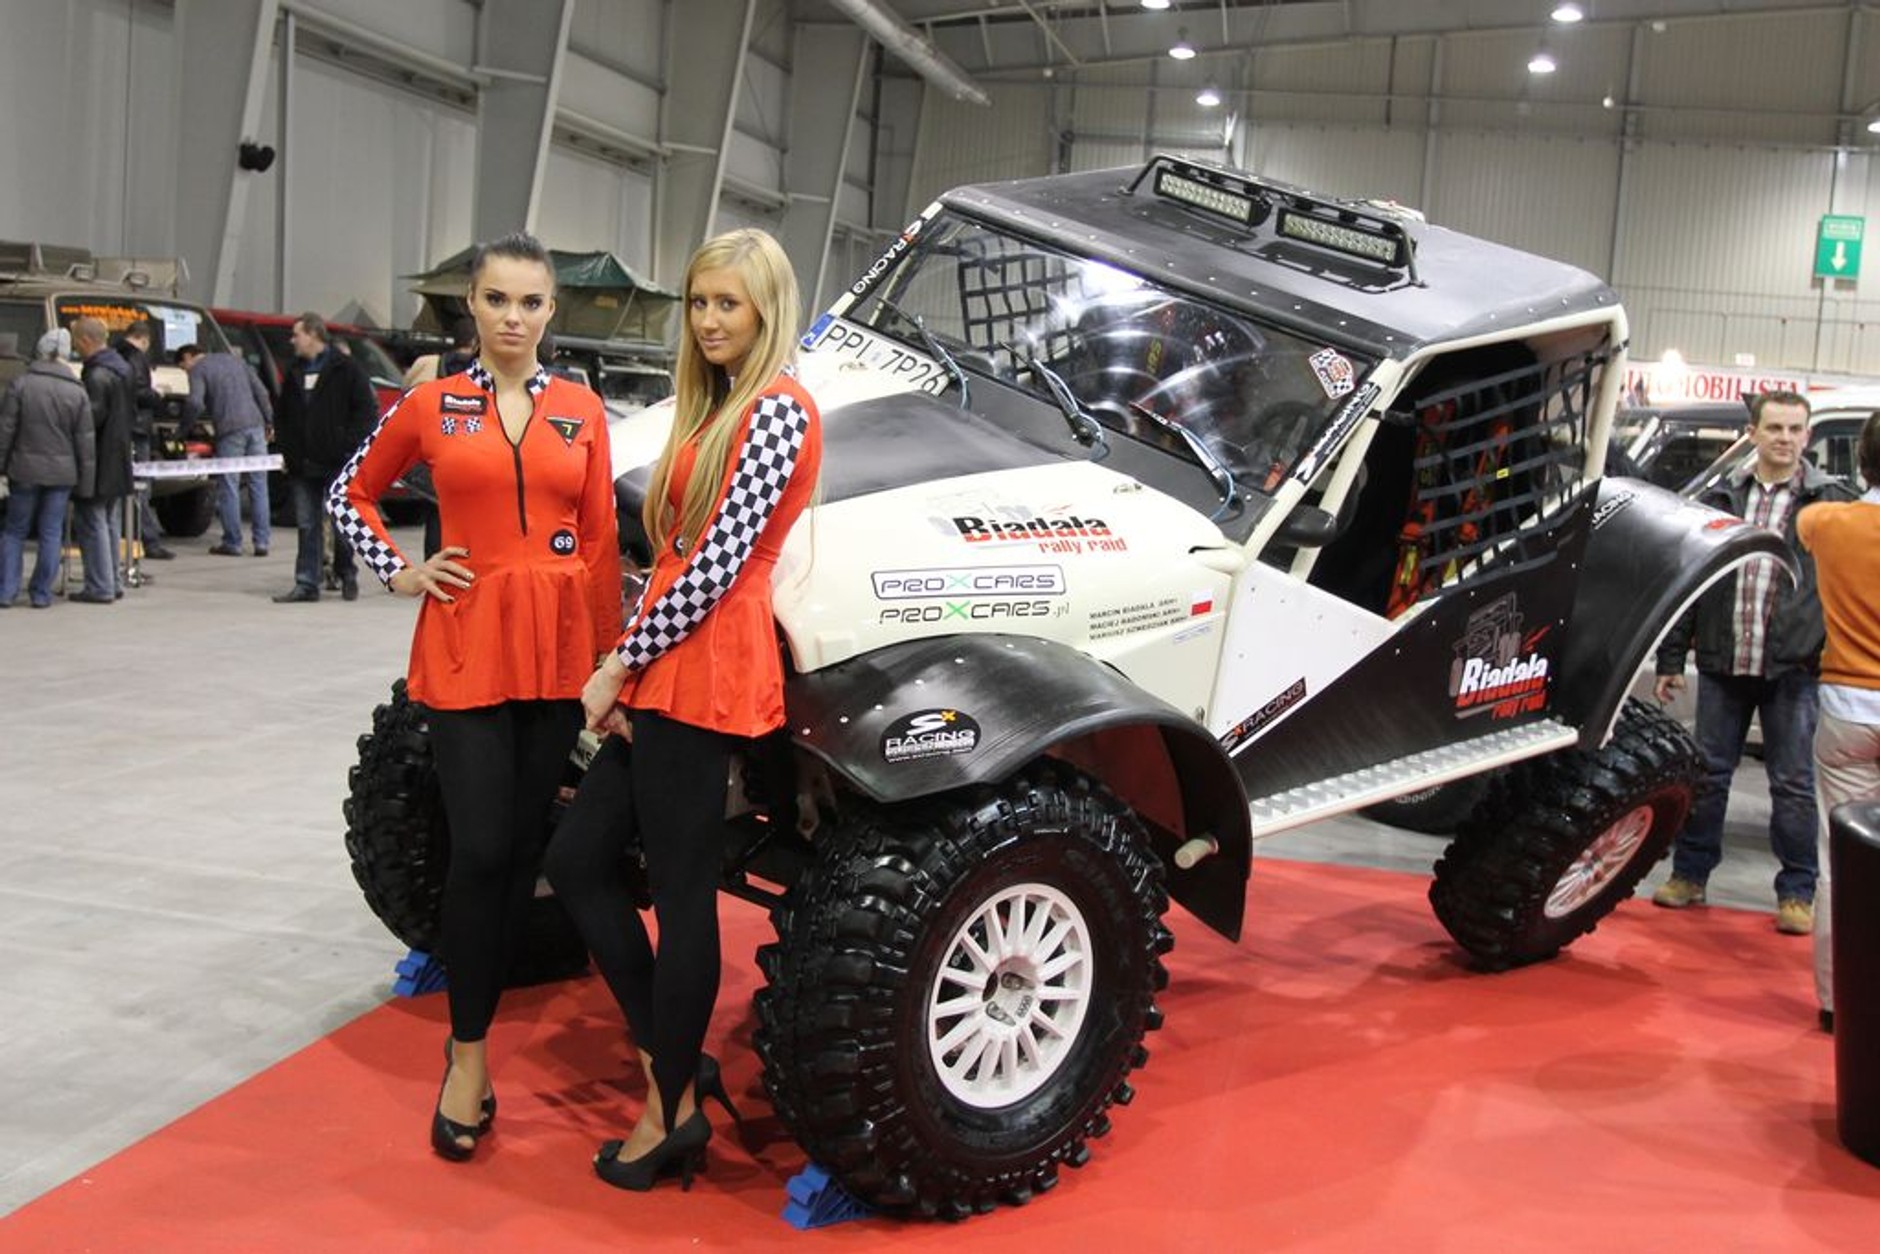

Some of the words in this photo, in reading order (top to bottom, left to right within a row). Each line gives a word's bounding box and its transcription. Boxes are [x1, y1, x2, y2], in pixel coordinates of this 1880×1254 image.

[851, 237, 908, 294] RACING
[952, 516, 1112, 543] Biadala
[553, 536, 575, 550] 69
[1038, 538, 1083, 554] rally
[1087, 537, 1127, 552] raid
[881, 574, 1056, 593] PROXCARS
[1456, 653, 1549, 708] Biadala
[1241, 681, 1304, 734] RACING
[885, 729, 976, 748] RACING
